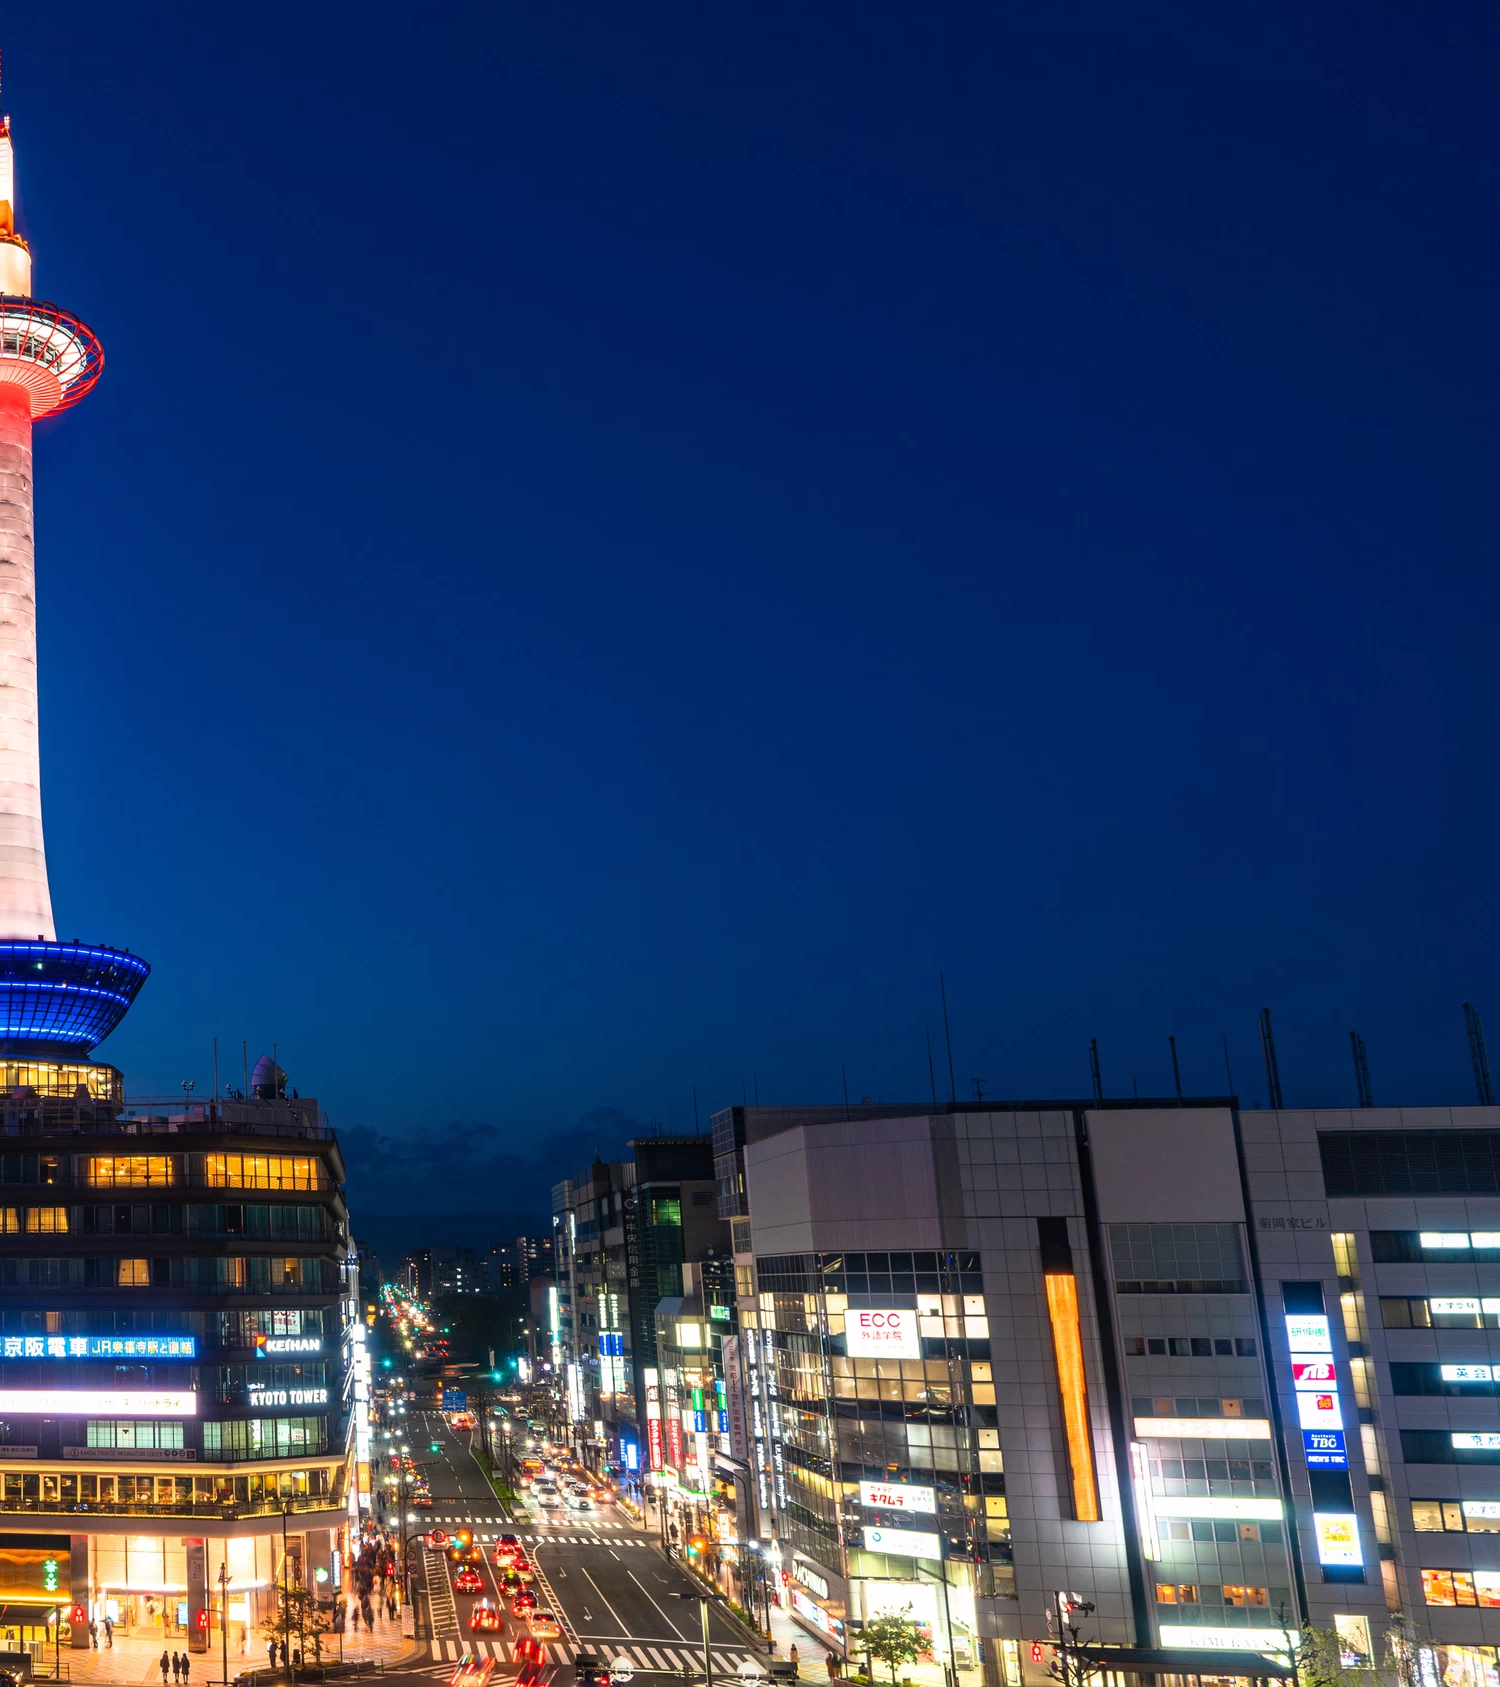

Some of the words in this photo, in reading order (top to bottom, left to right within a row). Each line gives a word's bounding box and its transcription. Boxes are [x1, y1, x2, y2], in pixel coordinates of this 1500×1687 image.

[1259, 1217, 1327, 1229] 菊岡家ビル
[860, 1313, 901, 1327] ECC
[862, 1331, 902, 1341] 外語学院
[4, 1336, 88, 1357] 京阪電車
[266, 1339, 320, 1352] KEIHAN
[1299, 1364, 1329, 1381] JTB
[250, 1391, 287, 1406] KYOTO
[289, 1388, 328, 1404] TOWER
[1311, 1437, 1337, 1448] TBC
[870, 1493, 904, 1506] キタムラ
